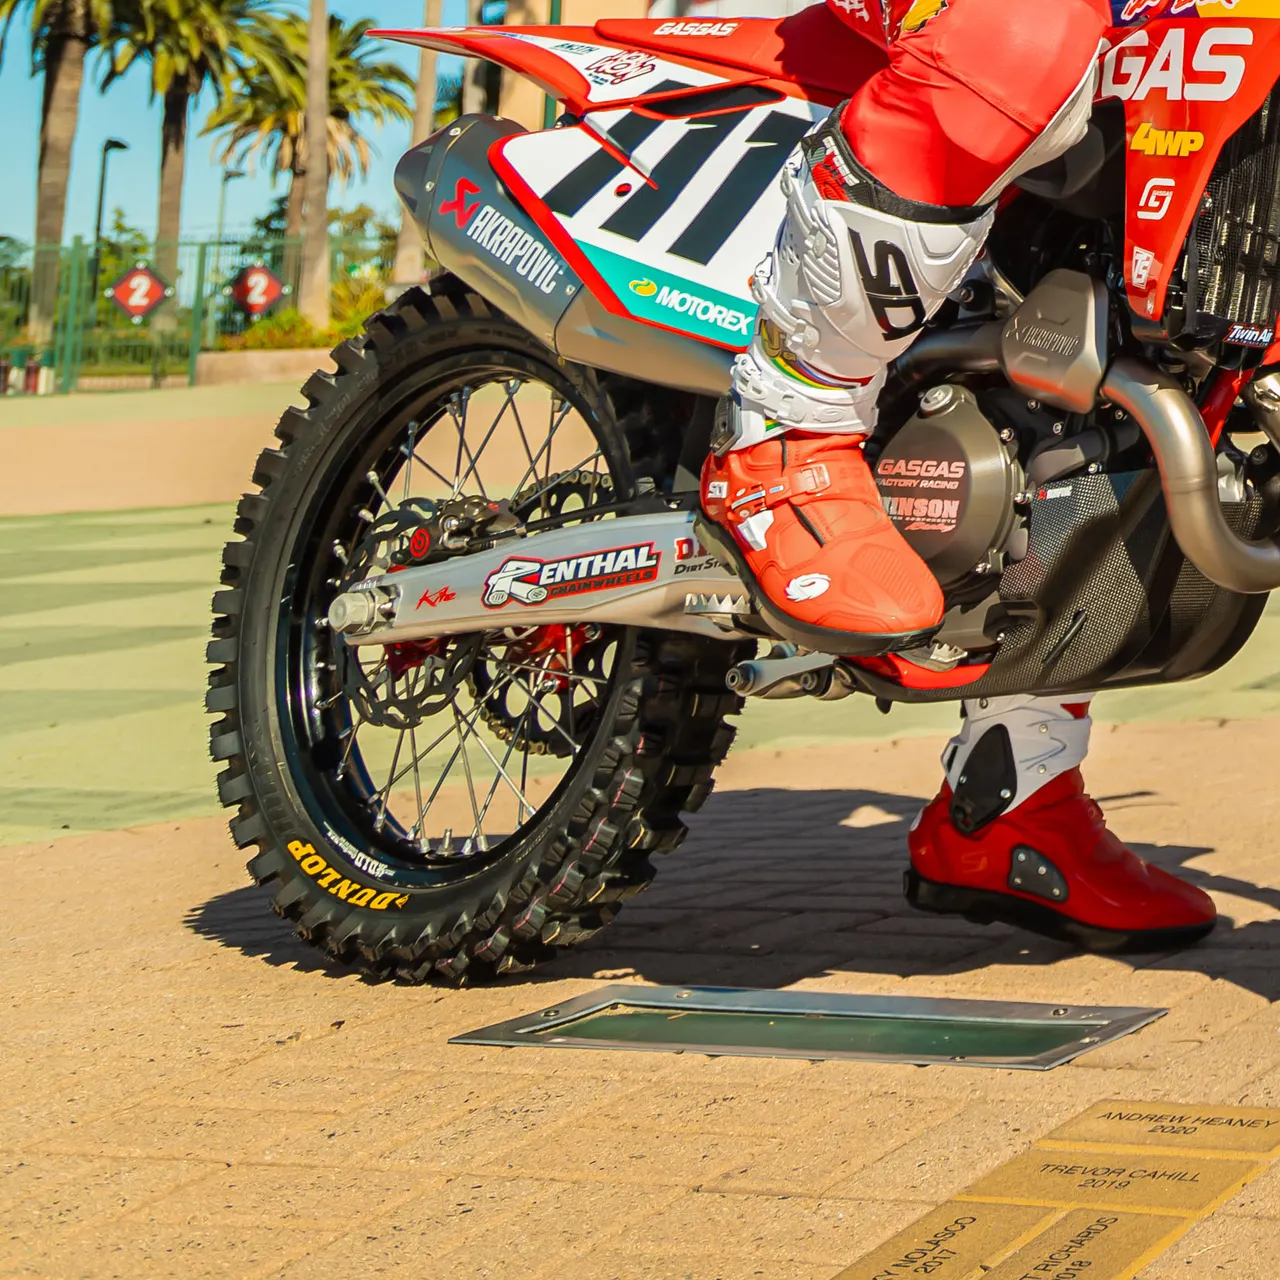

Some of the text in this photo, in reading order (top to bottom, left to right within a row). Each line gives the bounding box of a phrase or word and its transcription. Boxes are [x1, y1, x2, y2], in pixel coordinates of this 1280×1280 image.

[653, 22, 739, 37] GASGAS
[1101, 27, 1254, 103] GAS
[128, 276, 150, 306] 2
[247, 273, 267, 304] 2
[656, 285, 754, 337] MOTOREX
[1228, 324, 1260, 340] Twin
[877, 459, 966, 479] GASGAS
[919, 480, 959, 490] RACING
[287, 839, 402, 910] DUNLOP
[1098, 1111, 1279, 1130] ANDREW HEANEY
[1148, 1124, 1199, 1136] 2020
[1040, 1163, 1200, 1184] TREVOR CAHILL
[1077, 1178, 1132, 1191] 2019
[891, 1215, 977, 1268] NOLASCO
[1040, 1216, 1119, 1273] RICHARDS
[914, 1248, 958, 1274] 2017
